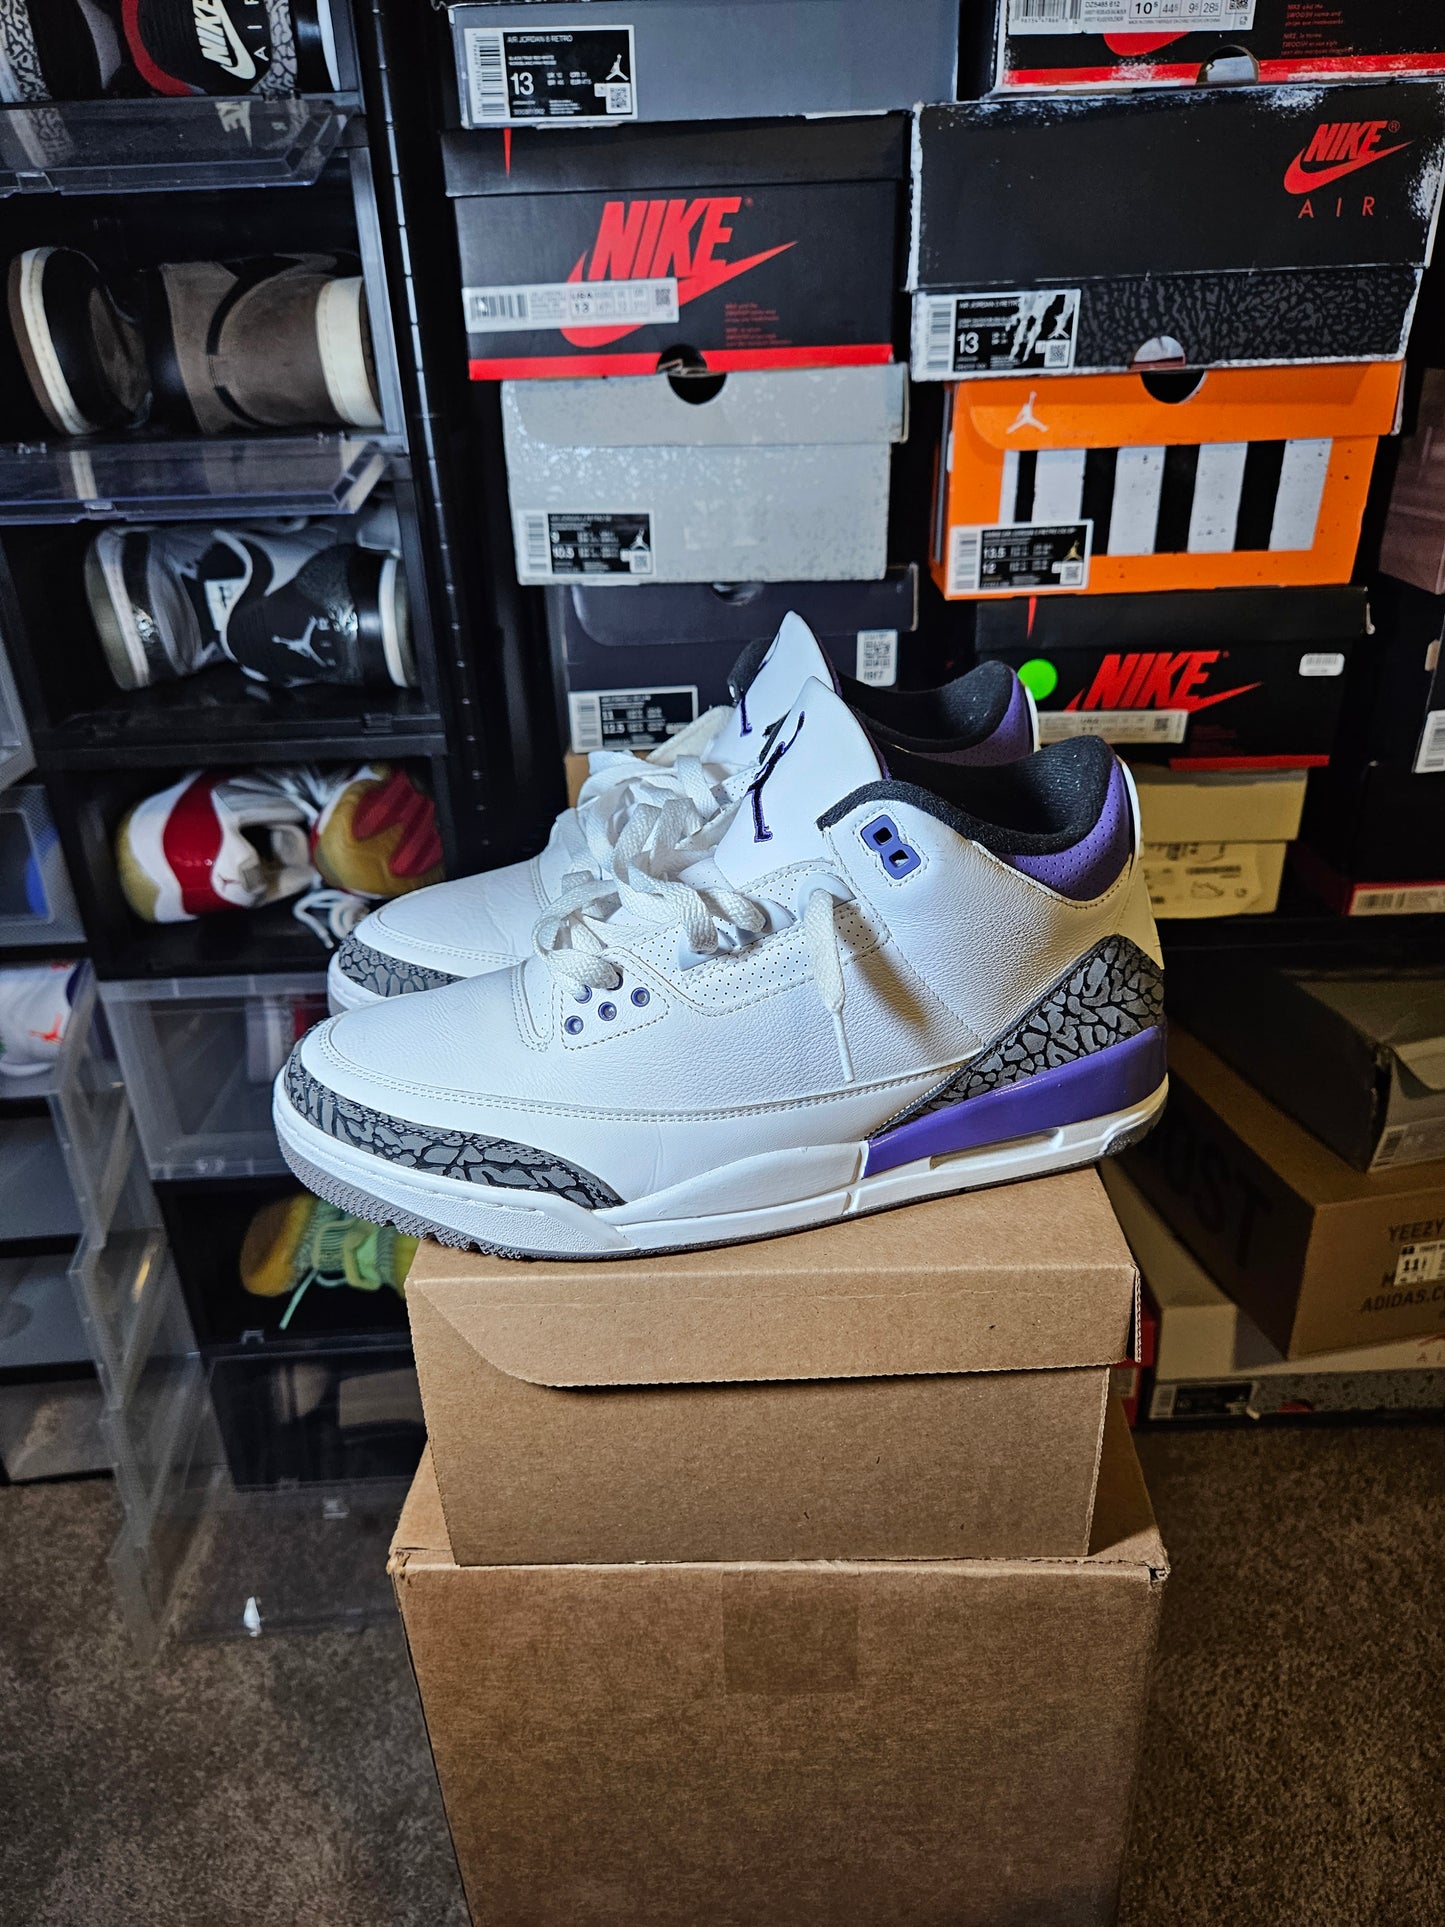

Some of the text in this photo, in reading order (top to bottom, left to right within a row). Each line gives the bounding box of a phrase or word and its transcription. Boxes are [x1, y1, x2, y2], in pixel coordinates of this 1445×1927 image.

[510, 72, 534, 95] 13
[1303, 120, 1388, 162] NIKE
[1298, 196, 1375, 218] AIR
[587, 197, 742, 281] NIKE
[957, 332, 979, 354] 13
[1082, 651, 1221, 710] NIKE
[1389, 1218, 1445, 1242] YEEZY
[1361, 1285, 1445, 1314] ADIDAS.C
